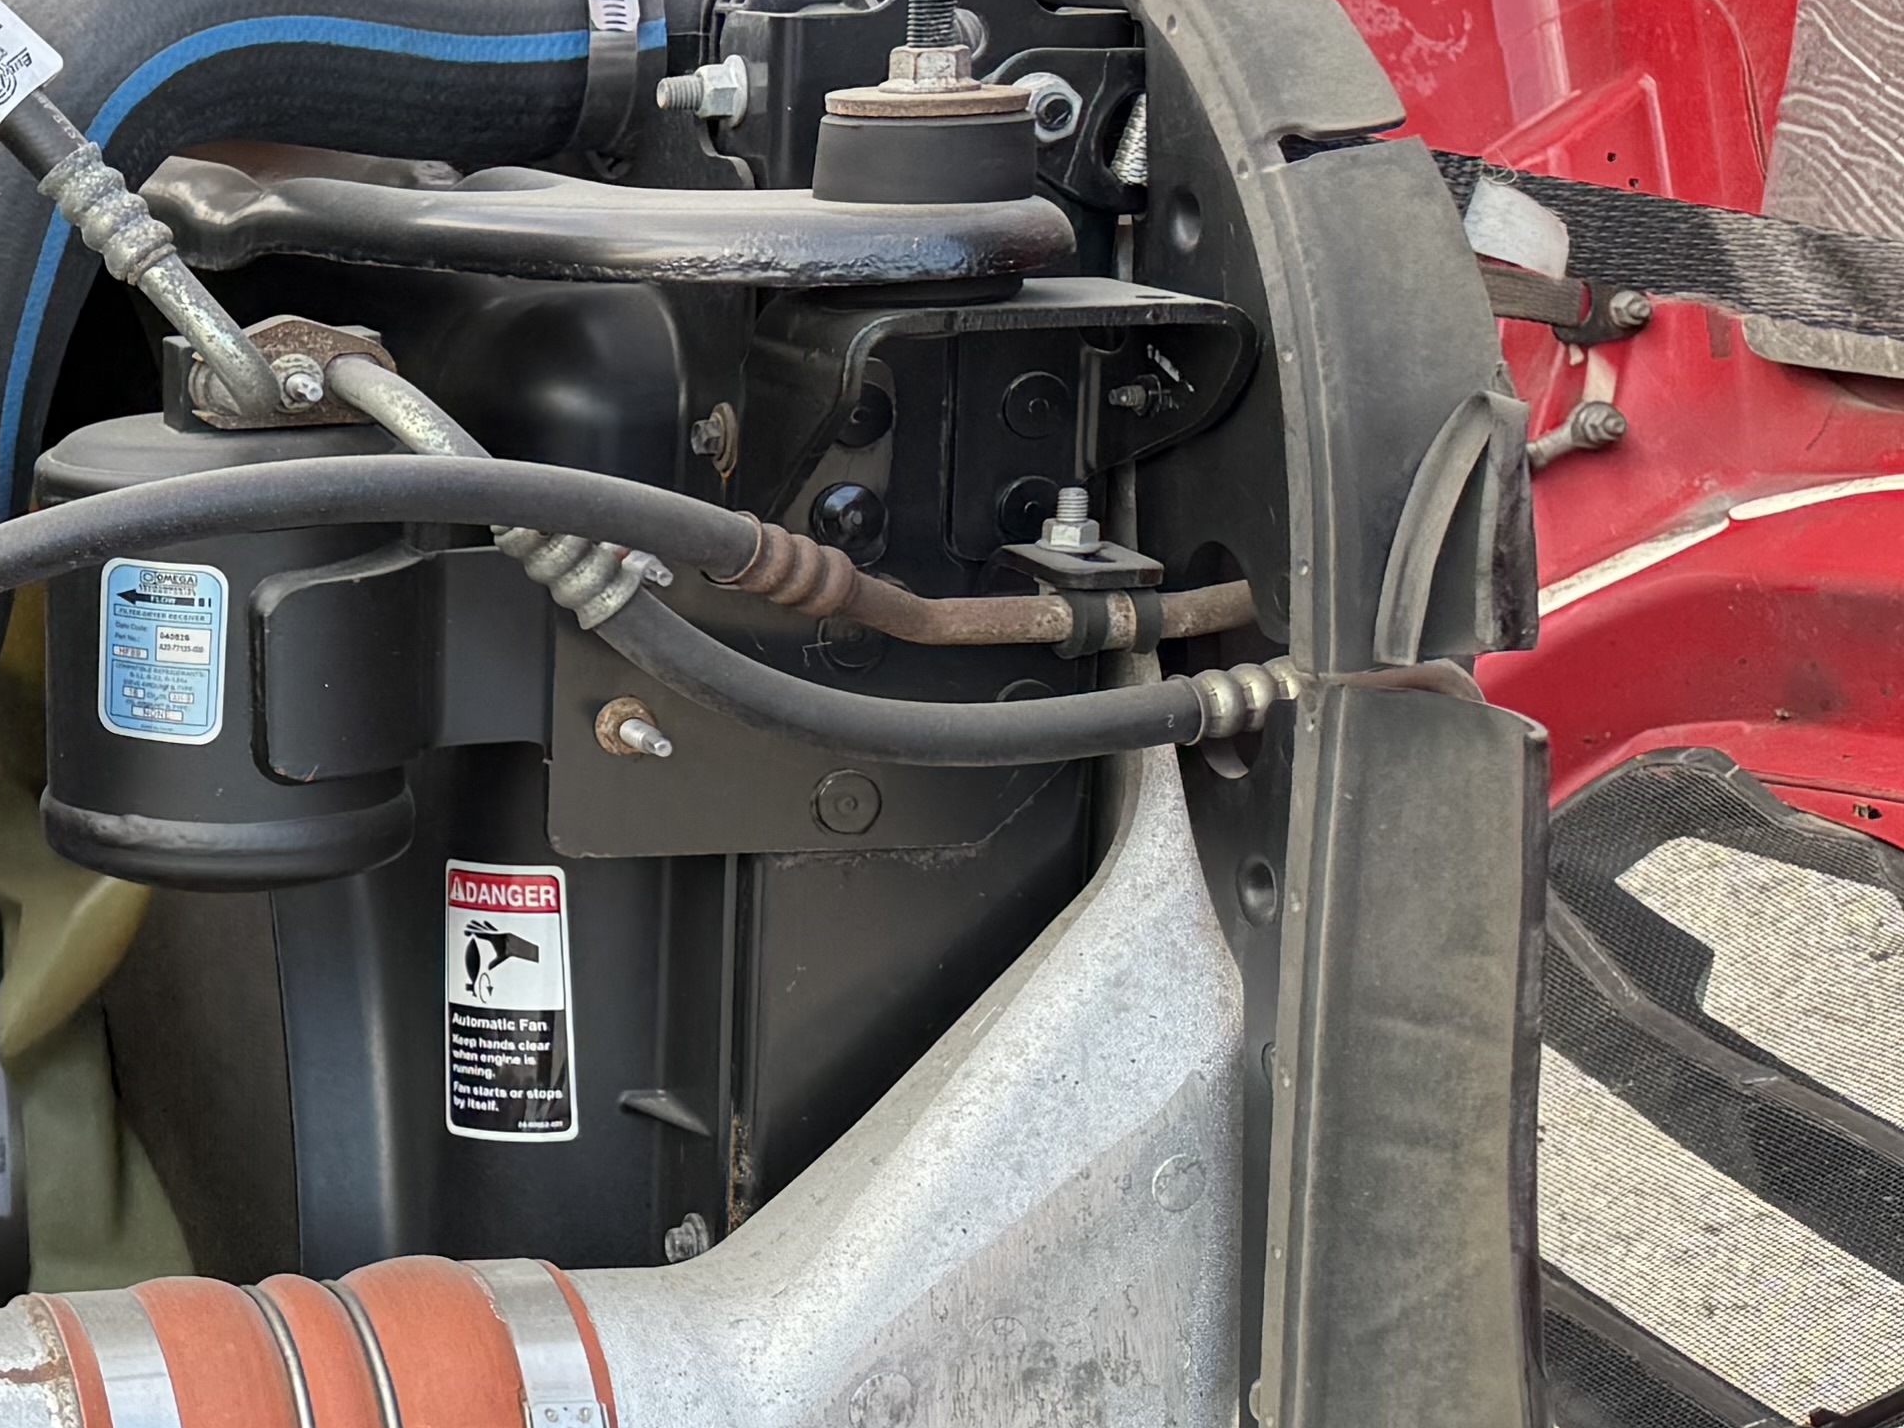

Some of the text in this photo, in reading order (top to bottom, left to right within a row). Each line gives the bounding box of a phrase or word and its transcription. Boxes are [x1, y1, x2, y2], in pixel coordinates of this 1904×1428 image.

[157, 573, 195, 585] OMEGA
[463, 881, 557, 908] DANGER
[452, 1012, 548, 1032] Automatic Fan
[452, 1033, 551, 1052] Keep hands clear
[452, 1049, 537, 1067] when engine is
[452, 1063, 496, 1080] running.
[453, 1080, 564, 1102] Fan starts or stops
[453, 1094, 500, 1112] by itself.
